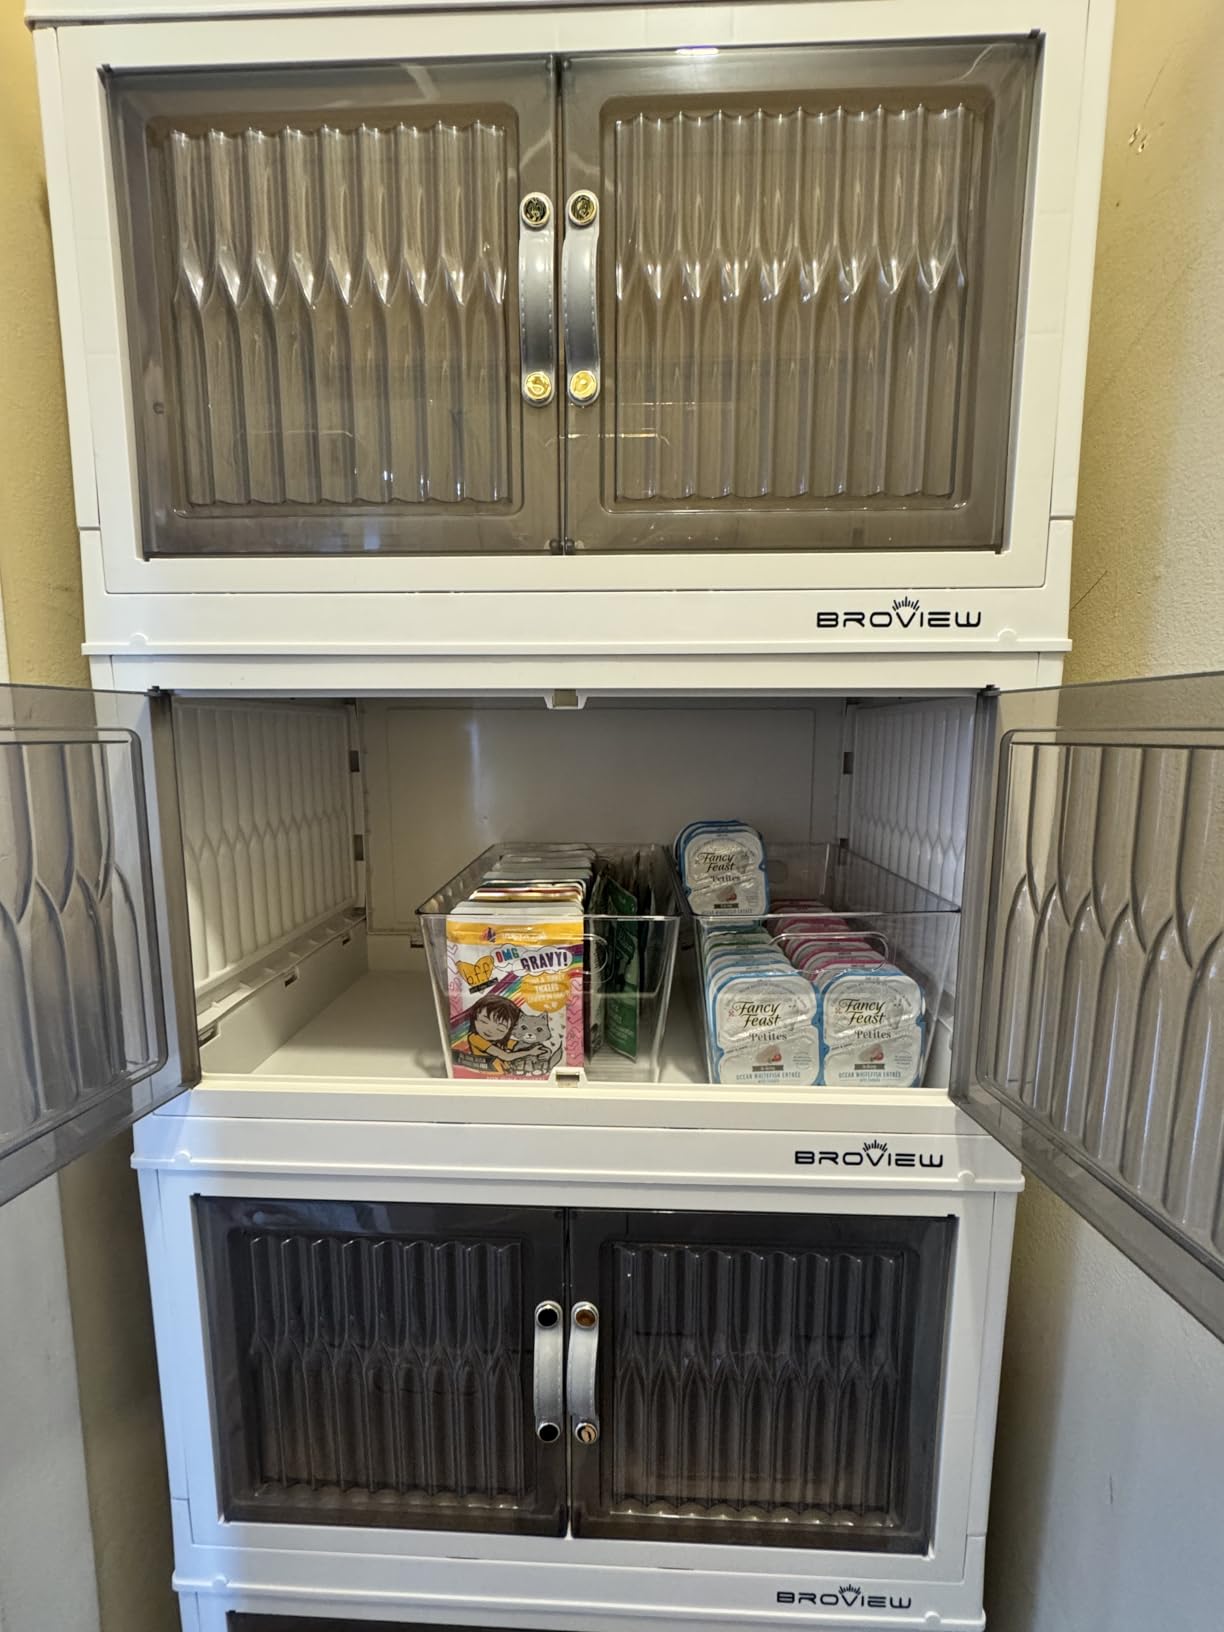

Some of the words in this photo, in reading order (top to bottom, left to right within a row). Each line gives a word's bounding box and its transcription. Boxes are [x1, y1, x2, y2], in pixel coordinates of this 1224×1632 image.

[816, 607, 982, 628] BROVIEW
[696, 852, 736, 866] Fancy
[706, 861, 737, 873] Feast
[495, 947, 519, 963] OMG
[520, 951, 568, 972] GRAVY!
[732, 1000, 781, 1017] Fancy
[838, 998, 886, 1015] Fancy
[742, 1013, 782, 1029] Feast
[847, 1011, 886, 1026] Feast
[750, 1031, 788, 1042] Petites
[855, 1029, 892, 1039] Petites
[794, 1149, 944, 1169] BROVIEW
[776, 1589, 913, 1609] BROVIEW
